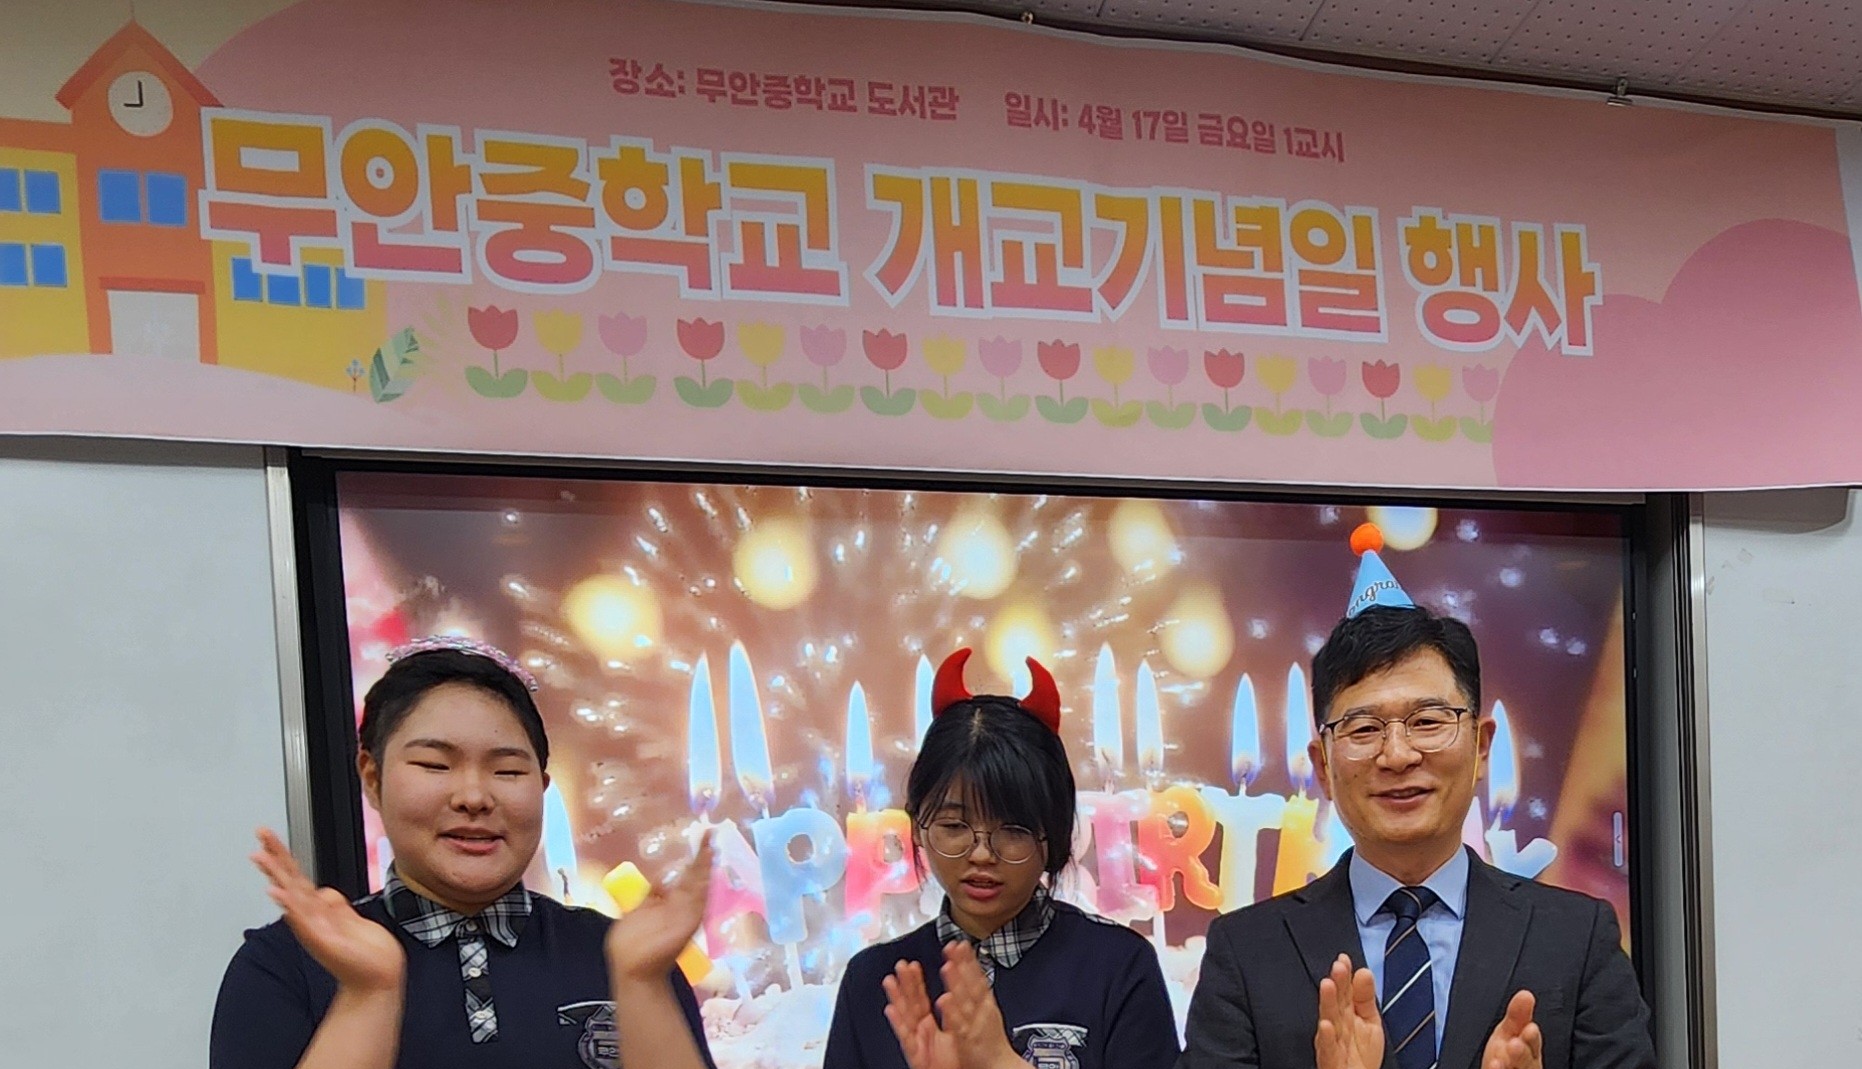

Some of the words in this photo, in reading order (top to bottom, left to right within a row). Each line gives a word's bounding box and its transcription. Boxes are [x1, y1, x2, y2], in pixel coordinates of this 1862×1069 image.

[608, 57, 686, 99] 장소:
[695, 67, 858, 113] 무안중학교
[867, 81, 960, 121] 도서관
[1004, 91, 1068, 131] 일시:
[1078, 103, 1124, 141] 4월
[1131, 110, 1189, 144] 17일
[1197, 113, 1277, 155] 금요일
[1283, 126, 1345, 163] 1교시
[200, 109, 847, 304] 무안중학교
[865, 165, 1389, 341] 개교기념일
[1398, 206, 1602, 356] 행사
